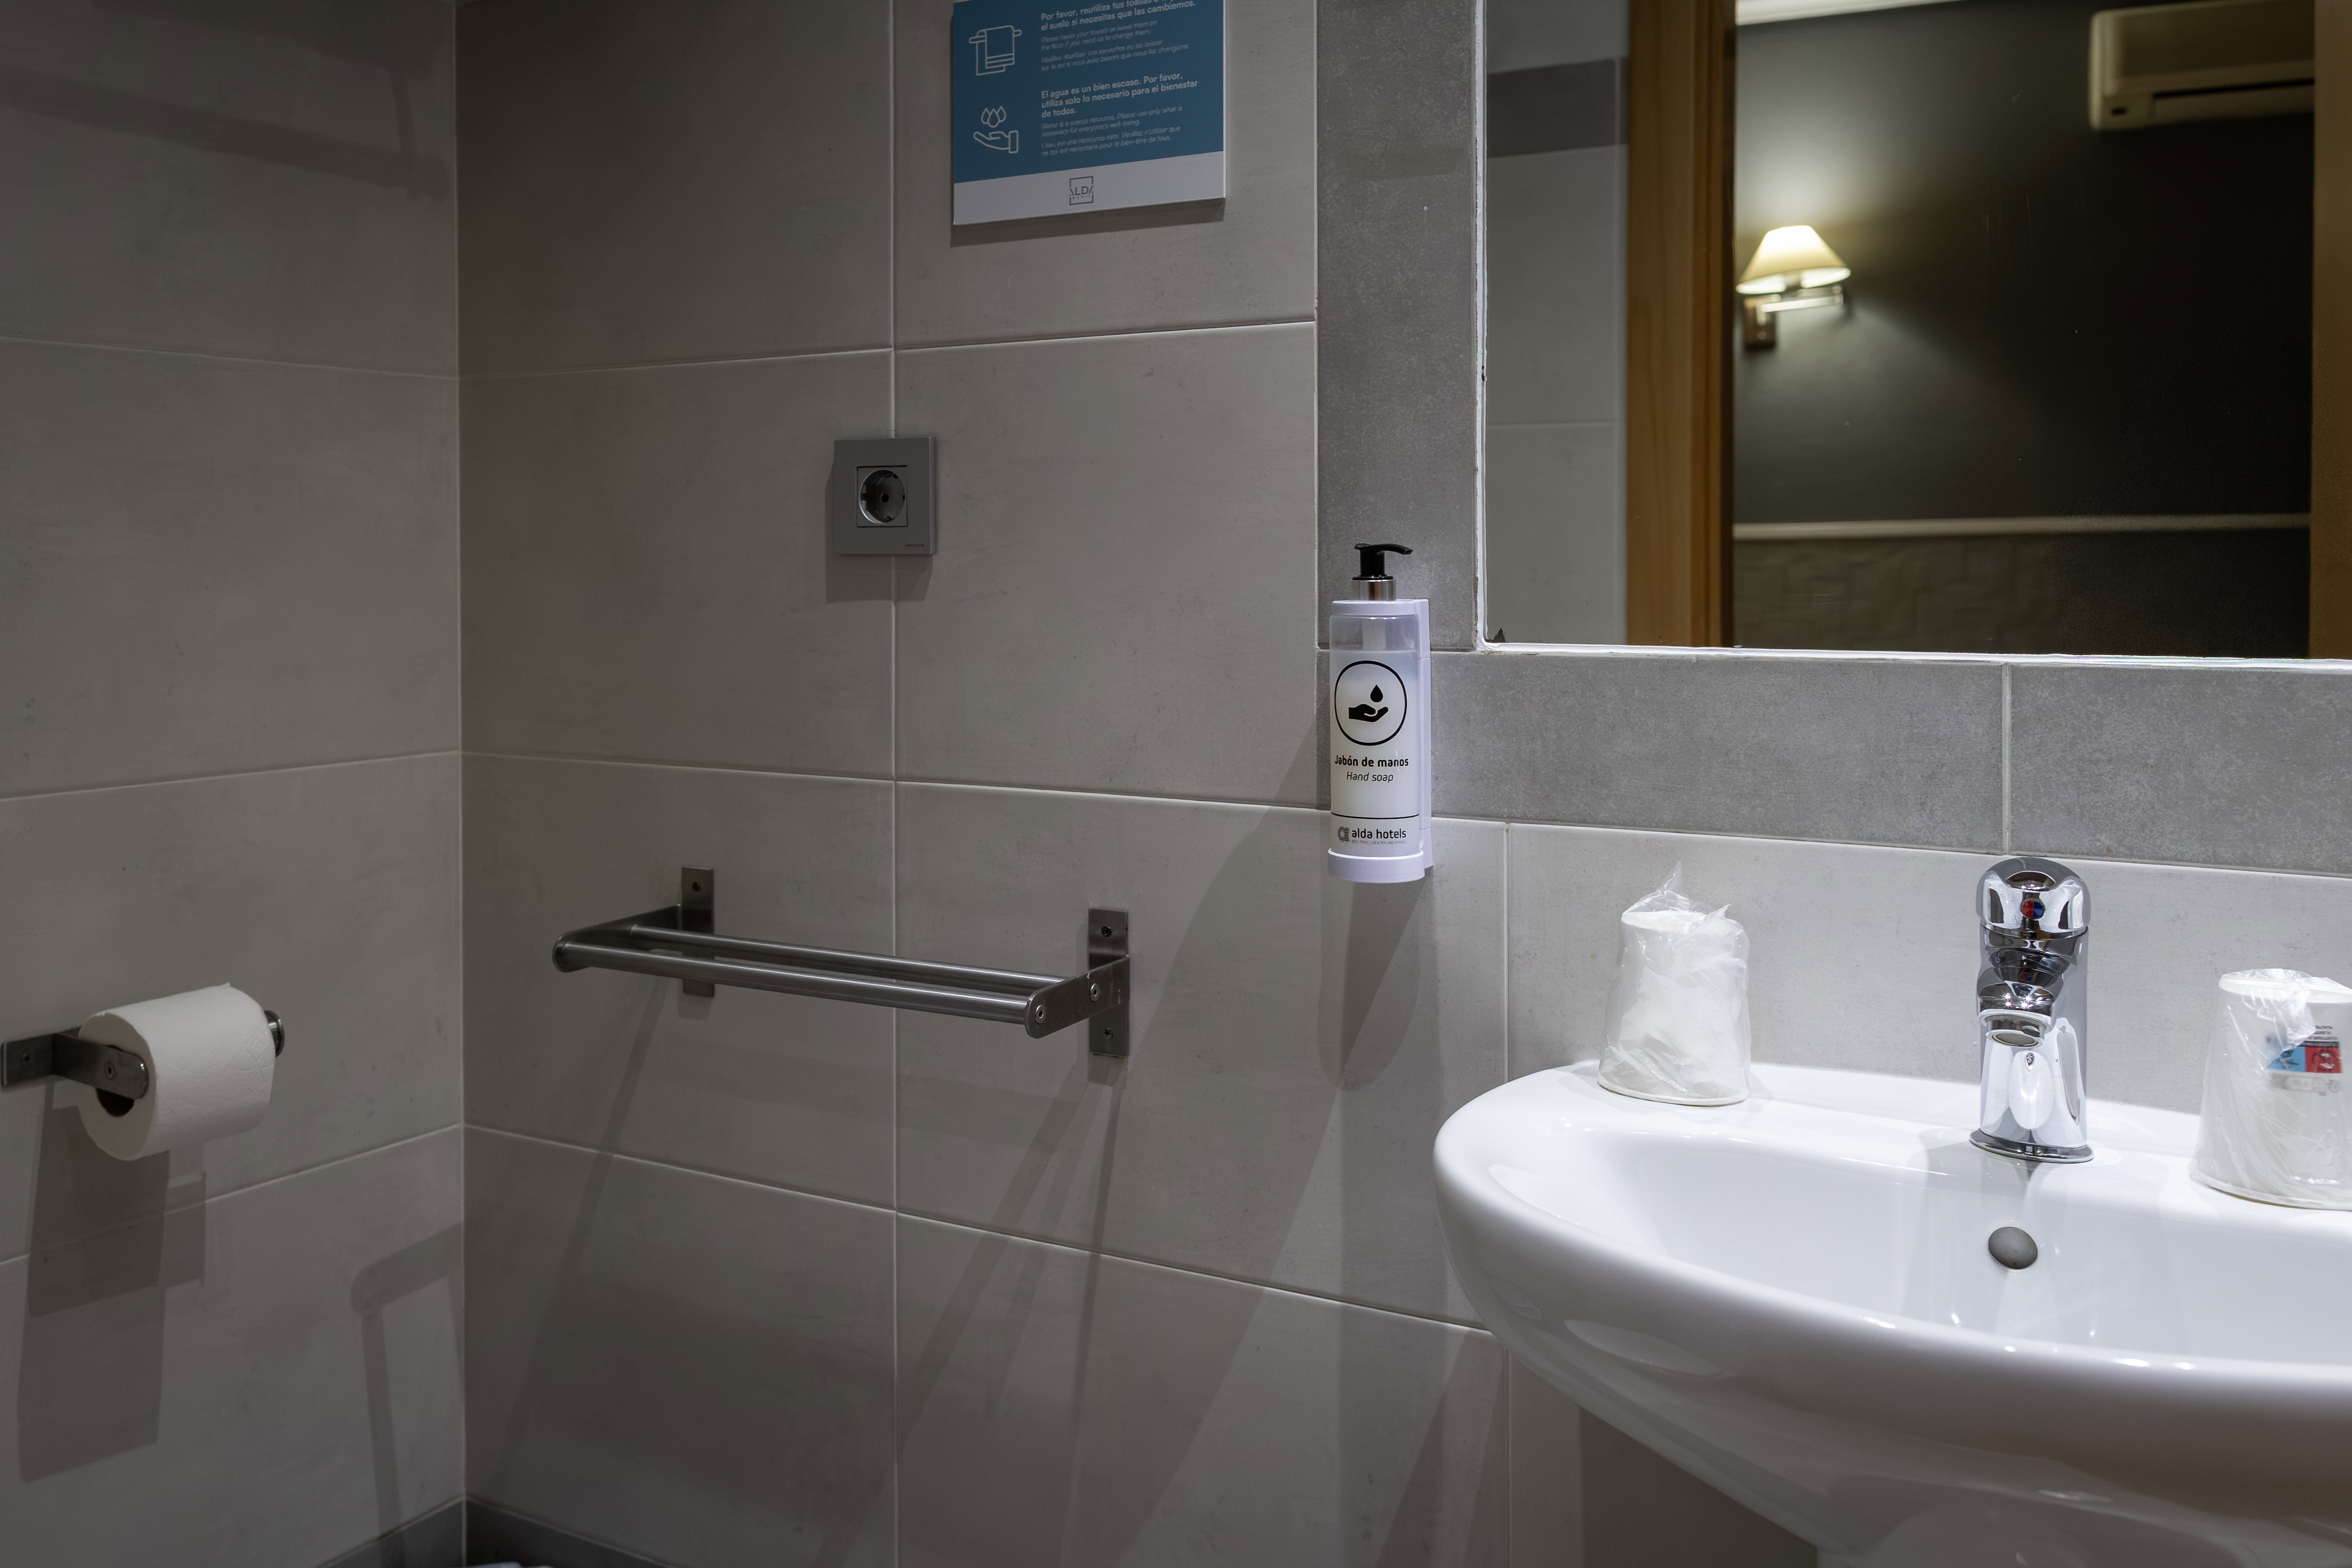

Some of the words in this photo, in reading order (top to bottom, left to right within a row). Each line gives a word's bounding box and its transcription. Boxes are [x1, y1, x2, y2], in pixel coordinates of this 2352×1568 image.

[1080, 4, 1110, 14] reutiliza
[1041, 23, 1048, 31] el
[1050, 21, 1070, 29] suelo
[1079, 13, 1115, 24] necesitas
[1117, 11, 1132, 20] que
[1134, 8, 1145, 16] las
[1147, 0, 1196, 13] cambiemos.
[1041, 91, 1048, 99] El
[1050, 90, 1069, 99] agua
[1093, 83, 1110, 91] bien
[1112, 79, 1141, 88] escaso.
[1144, 76, 1158, 84] Por
[1041, 100, 1063, 108] utiliza
[1065, 96, 1081, 105] solo
[1092, 89, 1130, 101] necesario
[1132, 88, 1150, 98] para
[1151, 85, 1159, 93] el
[1161, 80, 1198, 92] bienestar
[1053, 108, 1077, 116] todos.
[1334, 755, 1358, 766] Jabón
[1362, 756, 1374, 767] de
[1377, 758, 1409, 767] manos
[1346, 771, 1369, 781] Hand
[1371, 774, 1394, 783] soap
[1352, 828, 1373, 839] alda
[1376, 828, 1407, 839] hotels
